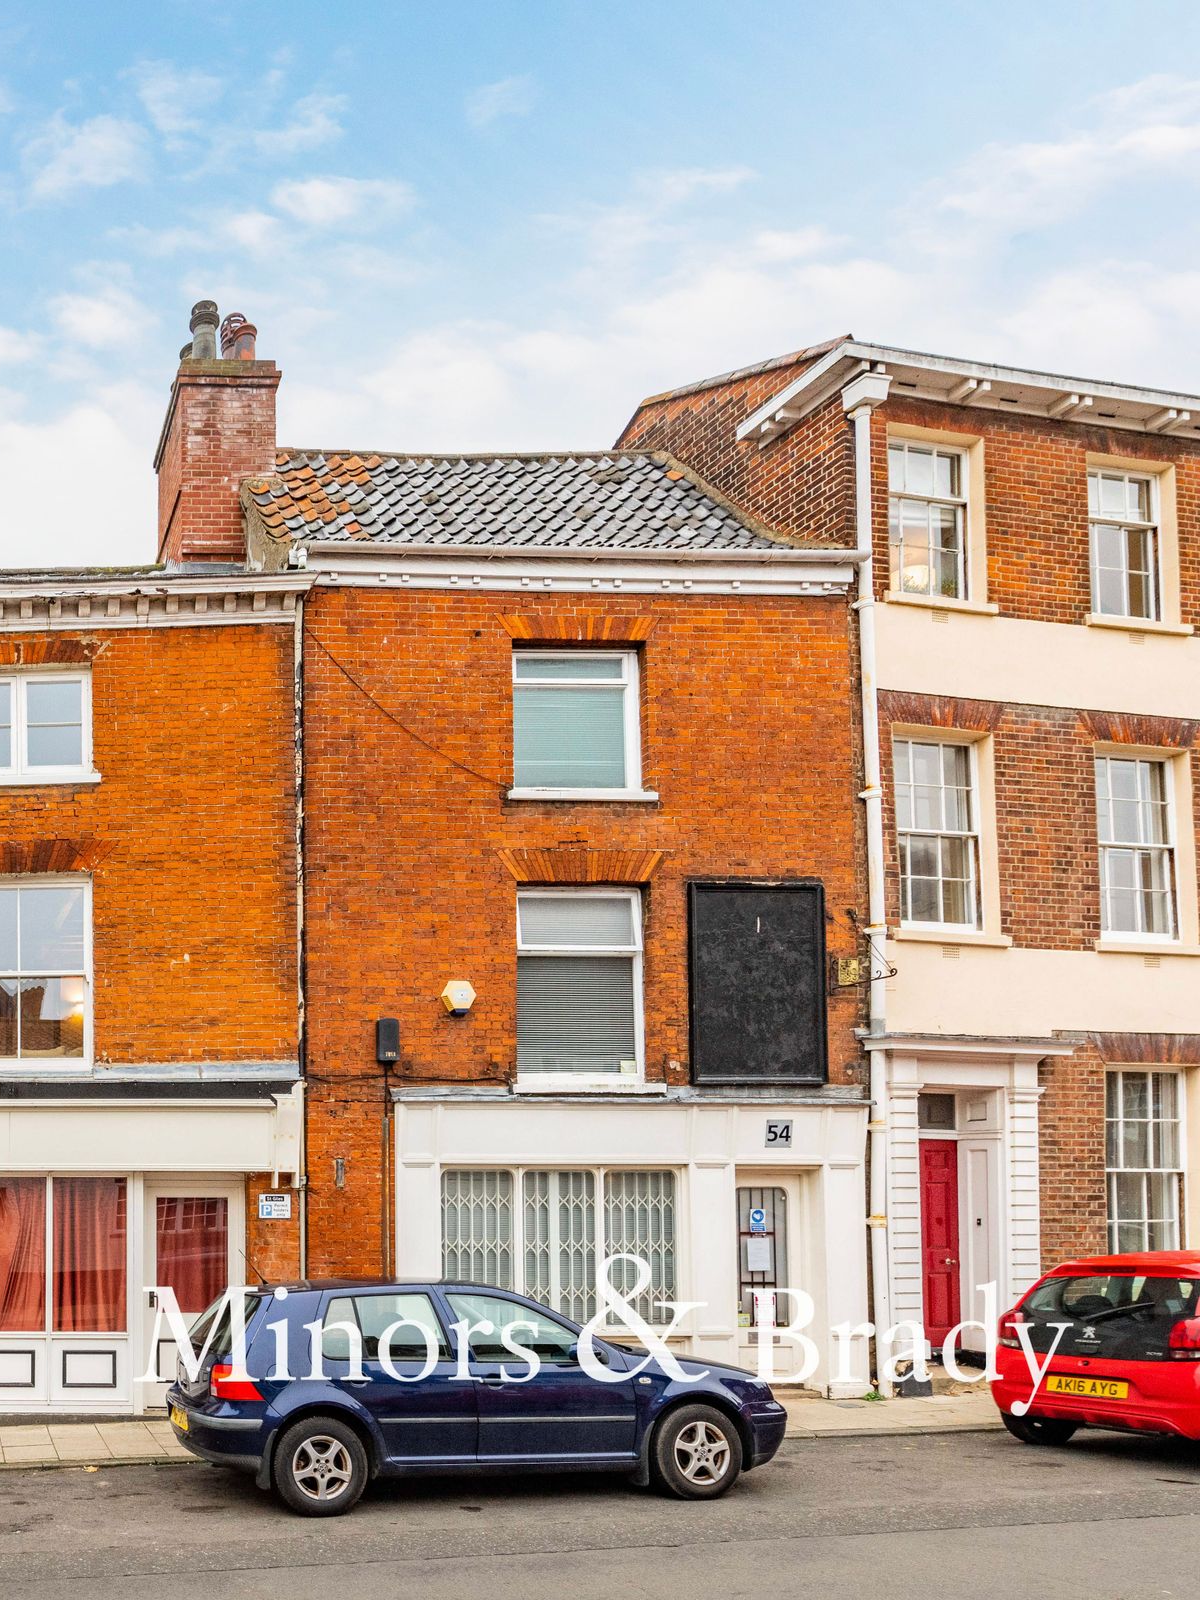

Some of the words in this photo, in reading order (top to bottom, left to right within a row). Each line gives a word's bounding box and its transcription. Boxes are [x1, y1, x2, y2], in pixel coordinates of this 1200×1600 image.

[767, 1124, 791, 1142] 54
[1056, 1378, 1086, 1392] AK16
[1089, 1382, 1119, 1396] AYG
